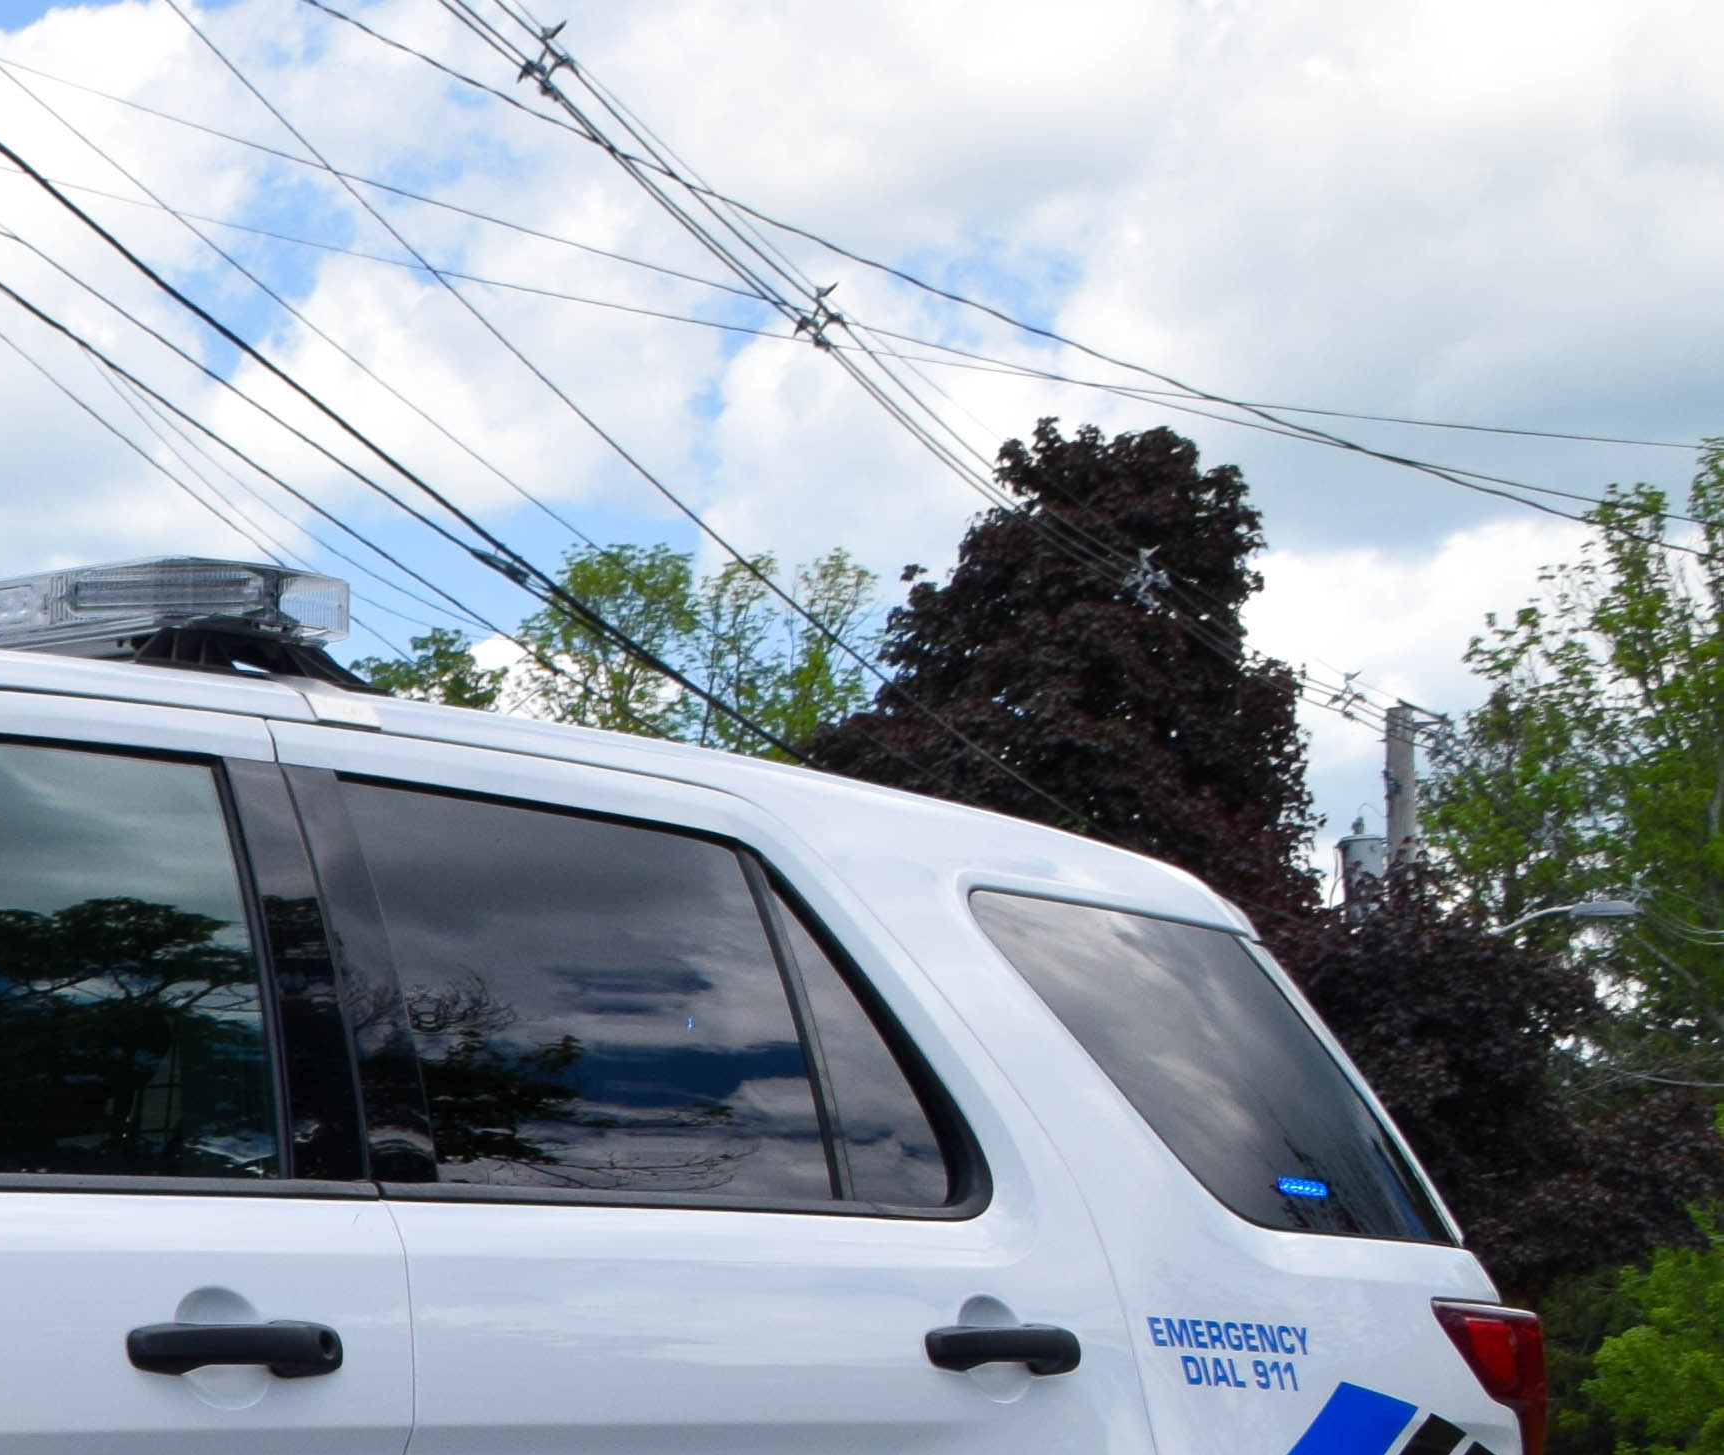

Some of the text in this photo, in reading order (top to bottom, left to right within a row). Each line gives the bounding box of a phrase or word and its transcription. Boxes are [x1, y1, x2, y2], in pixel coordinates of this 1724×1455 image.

[1146, 1316, 1309, 1355] EMERGENCY
[1180, 1355, 1300, 1391] DIAL 911
